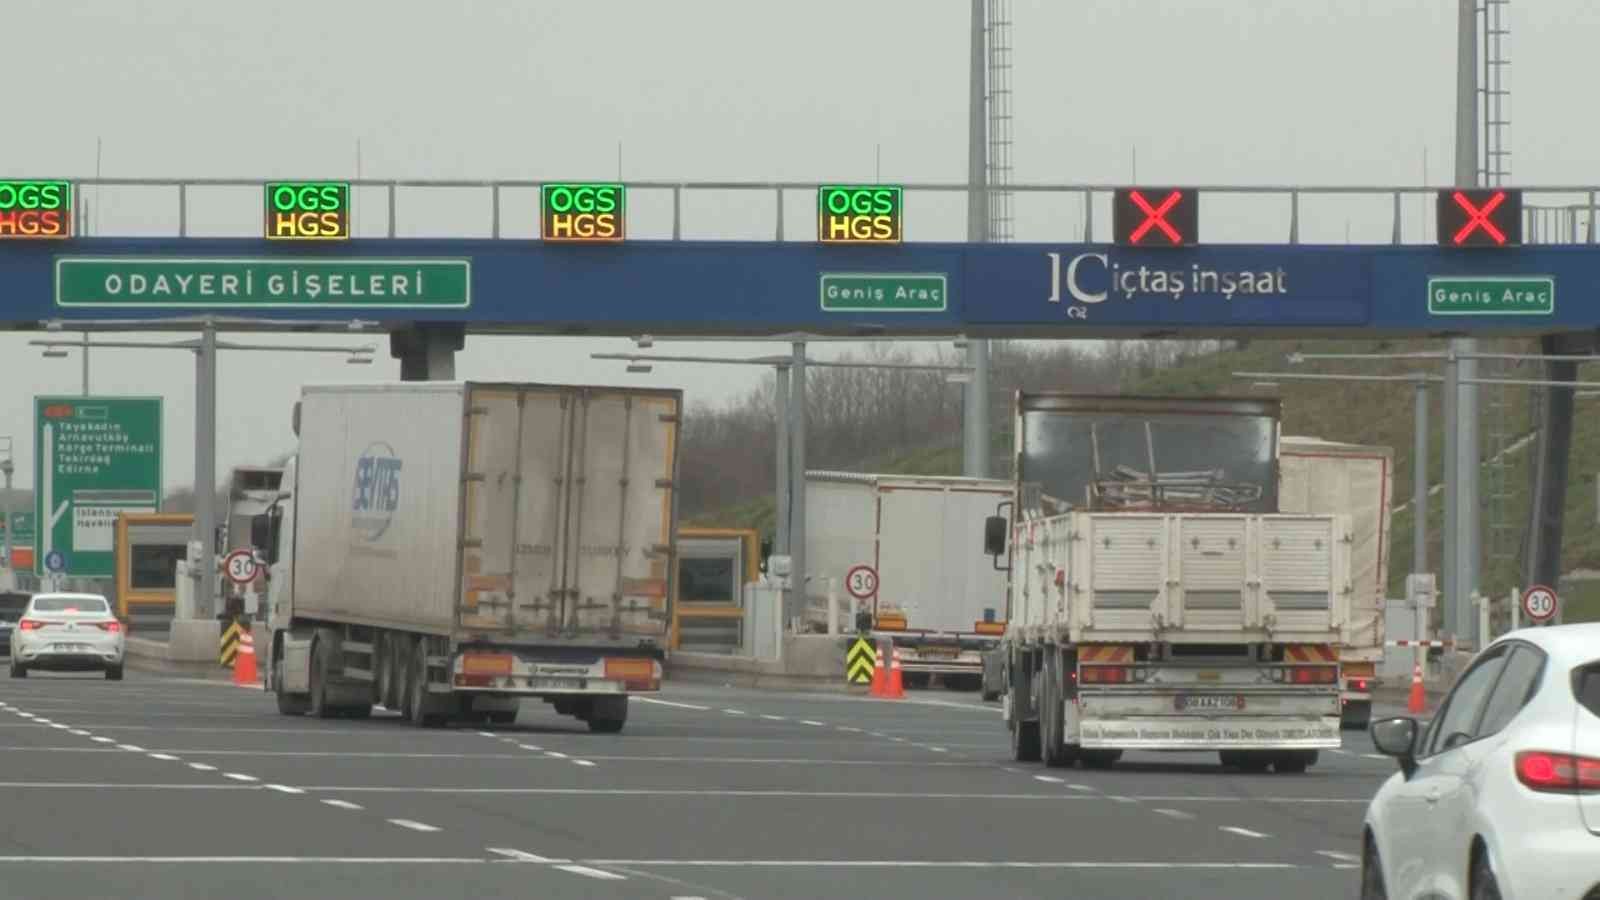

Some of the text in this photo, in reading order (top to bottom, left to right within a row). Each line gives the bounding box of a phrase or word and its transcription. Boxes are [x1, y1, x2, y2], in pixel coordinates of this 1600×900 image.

[0, 185, 60, 209] OGS
[274, 187, 340, 210] OGS
[551, 188, 615, 212] OGS
[828, 190, 892, 214] OGS
[0, 211, 60, 234] HGS
[276, 212, 340, 235] HGS
[553, 214, 615, 237] HGS
[830, 215, 892, 239] HGS
[105, 270, 424, 298] ODAYERİ GİŞELERİ
[827, 285, 940, 301] Geniş Araç
[1112, 263, 1185, 300] içtaş
[1192, 264, 1287, 300] inşaat
[1435, 288, 1547, 303] Geniş Araç
[232, 558, 254, 576] 30
[853, 573, 874, 590] 30
[1531, 595, 1551, 612] 30
